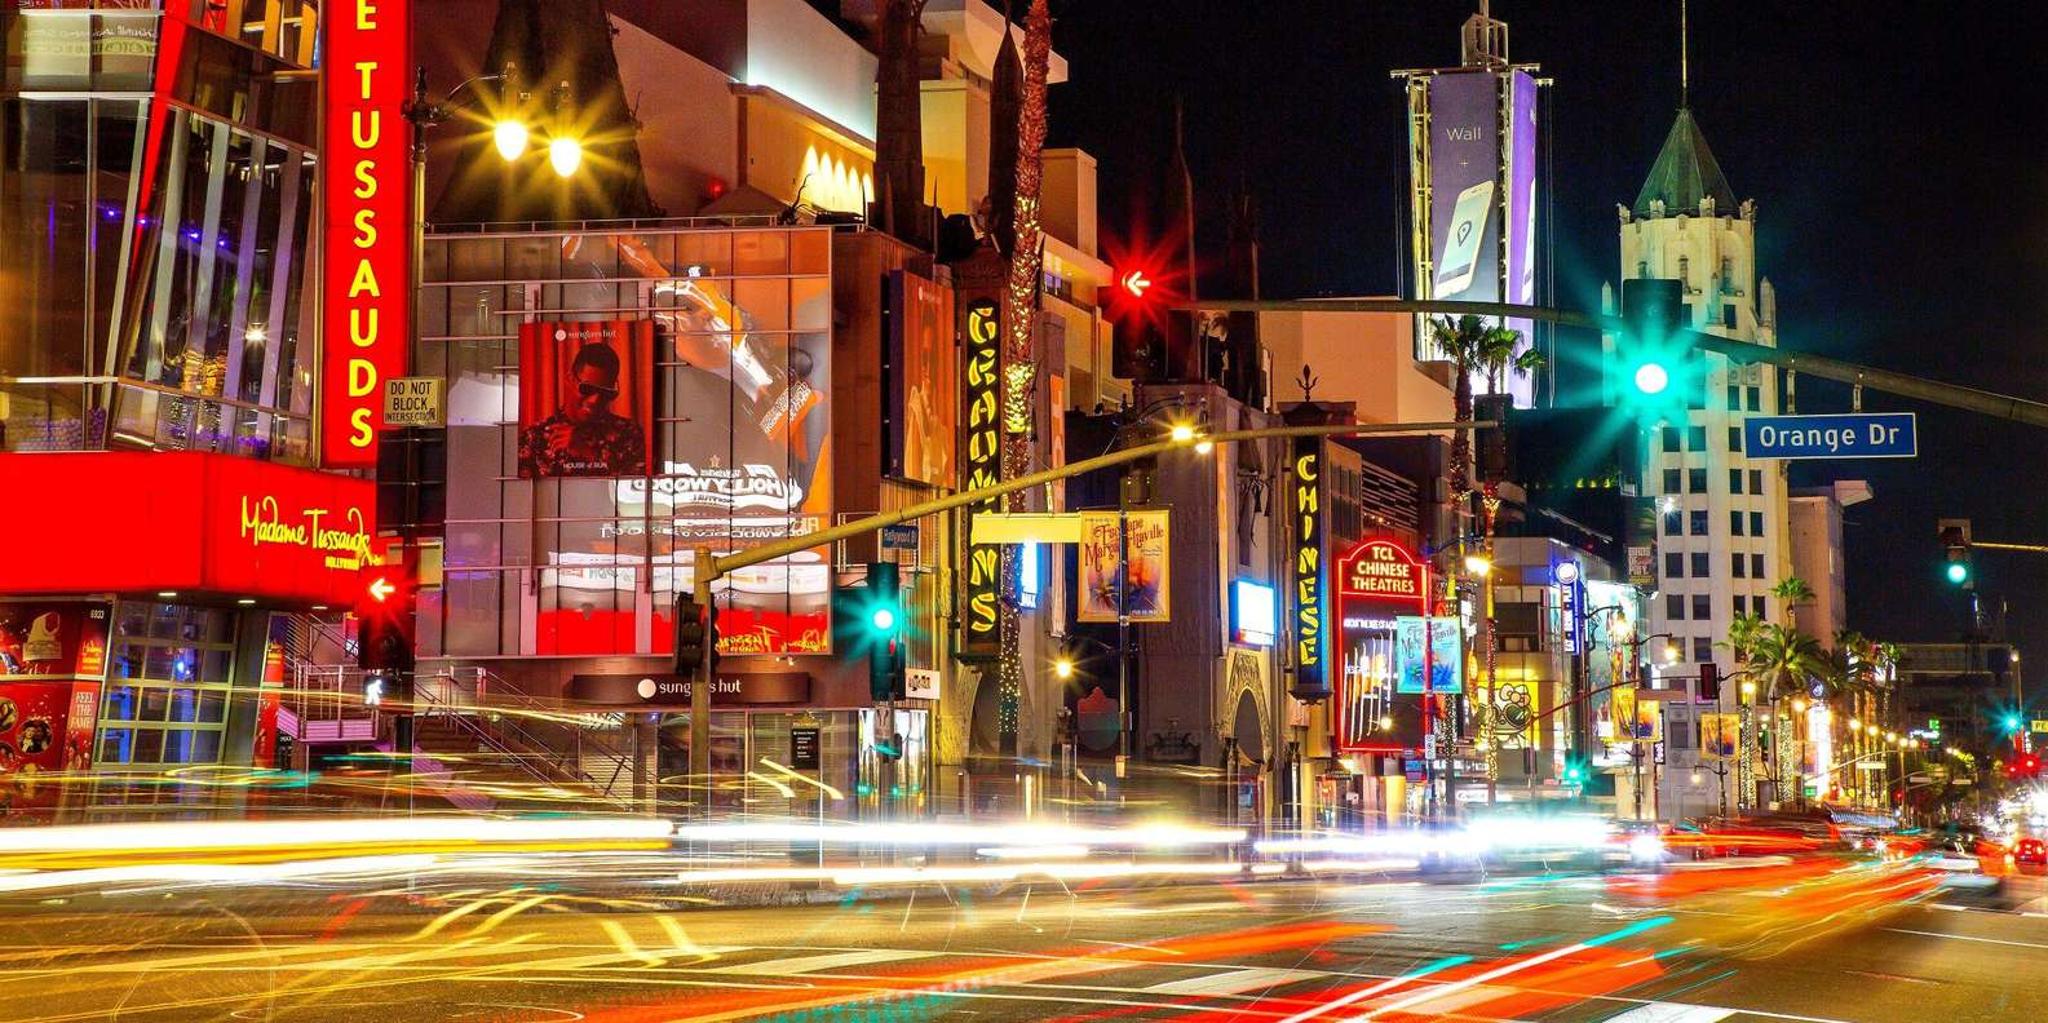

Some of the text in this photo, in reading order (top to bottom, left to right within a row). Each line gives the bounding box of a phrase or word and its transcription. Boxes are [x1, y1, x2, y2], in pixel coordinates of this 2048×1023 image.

[1446, 127, 1482, 141] Wall
[349, 61, 380, 447] TUSSAUDS
[391, 382, 432, 395] DO NOT
[393, 397, 427, 411] BLOCK
[1759, 423, 1900, 453] Orange Dr
[241, 496, 373, 566] Madame Tussauds
[1297, 454, 1319, 665] CHINESE
[1372, 546, 1395, 561] TCL
[1356, 561, 1410, 577] CHINESE
[1351, 576, 1415, 594] THEATRES
[719, 678, 741, 693] hut
